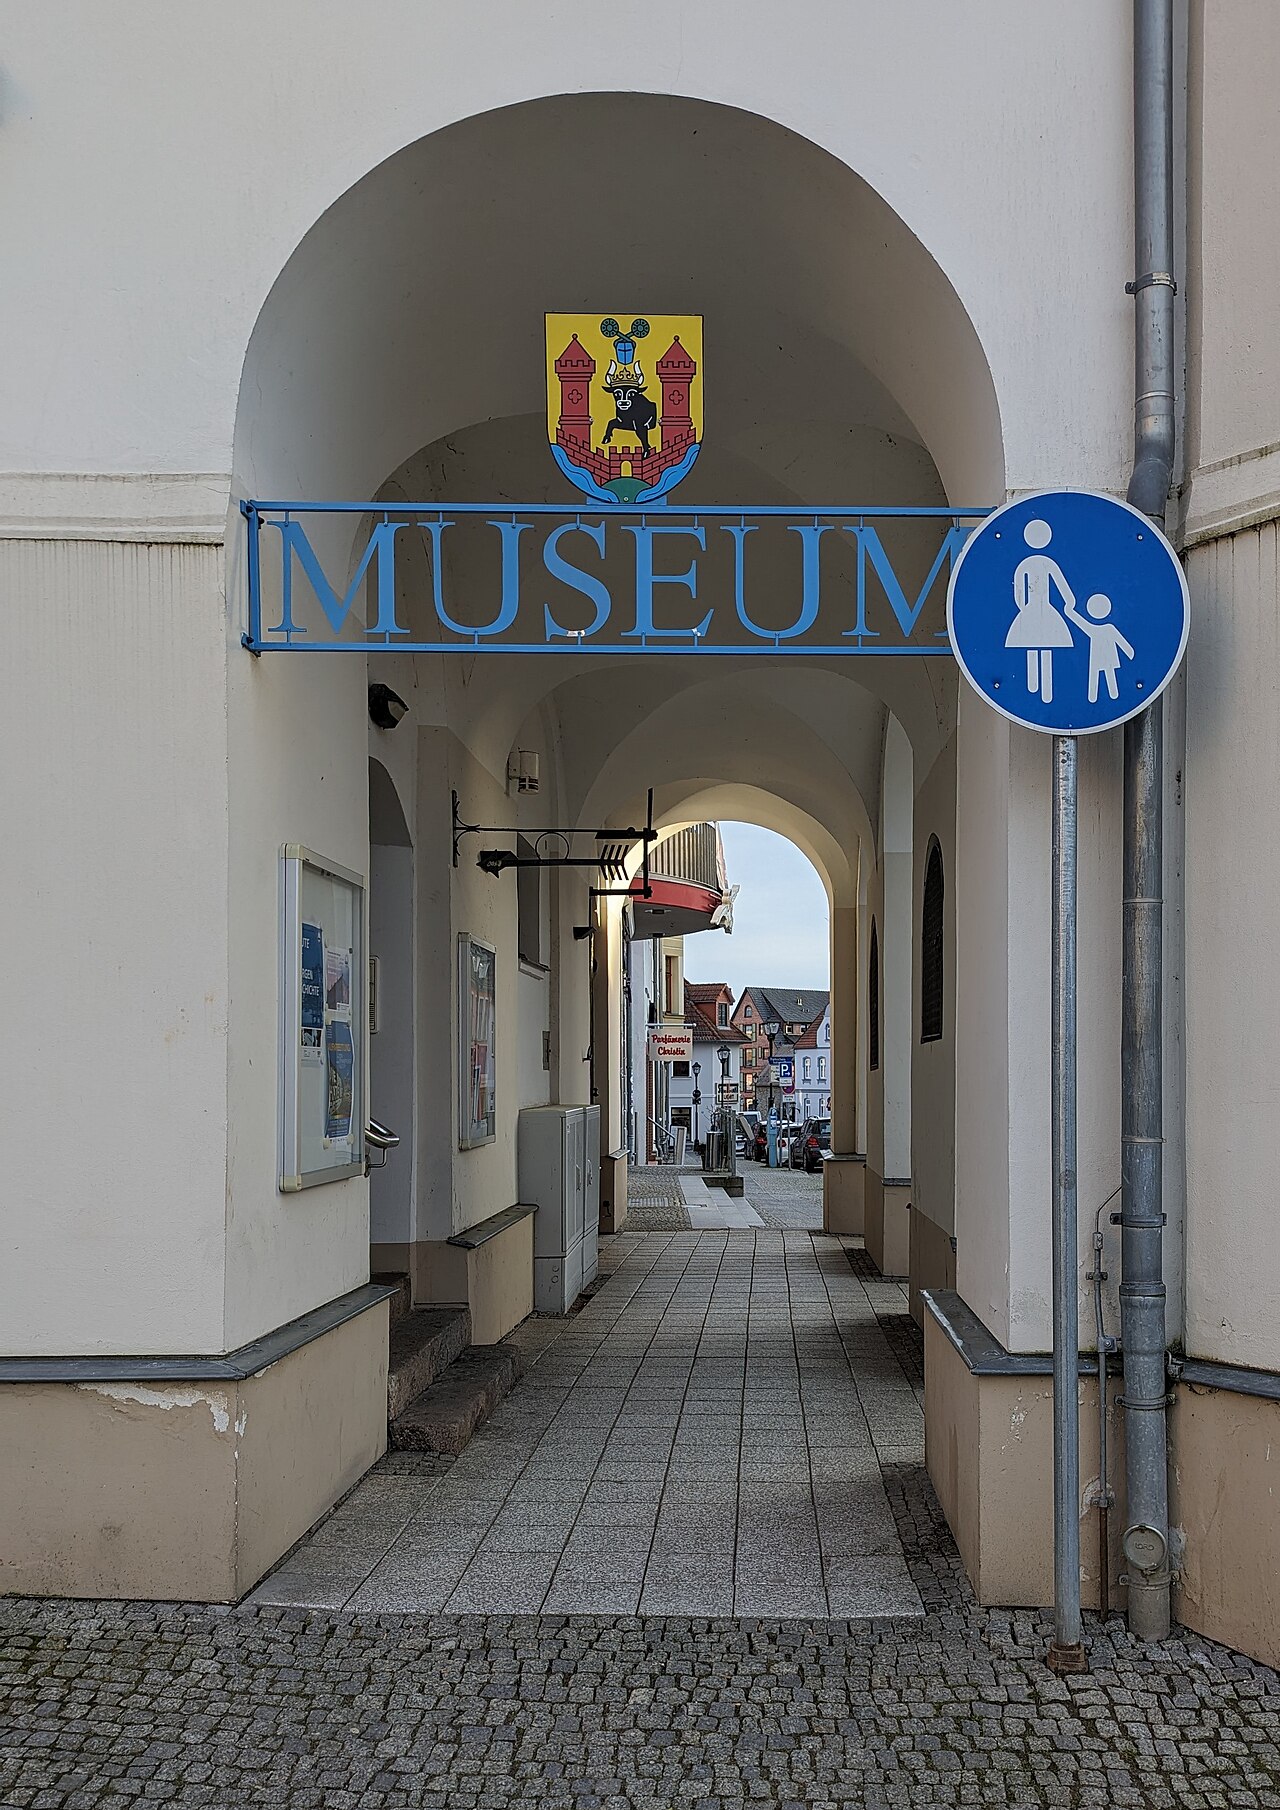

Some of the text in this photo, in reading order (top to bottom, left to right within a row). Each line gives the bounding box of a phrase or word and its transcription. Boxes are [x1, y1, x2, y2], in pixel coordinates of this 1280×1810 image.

[266, 520, 977, 642] MUSEUM
[652, 1034, 691, 1044] Parfümerie
[658, 1046, 686, 1055] Christin
[781, 1063, 789, 1077] P
